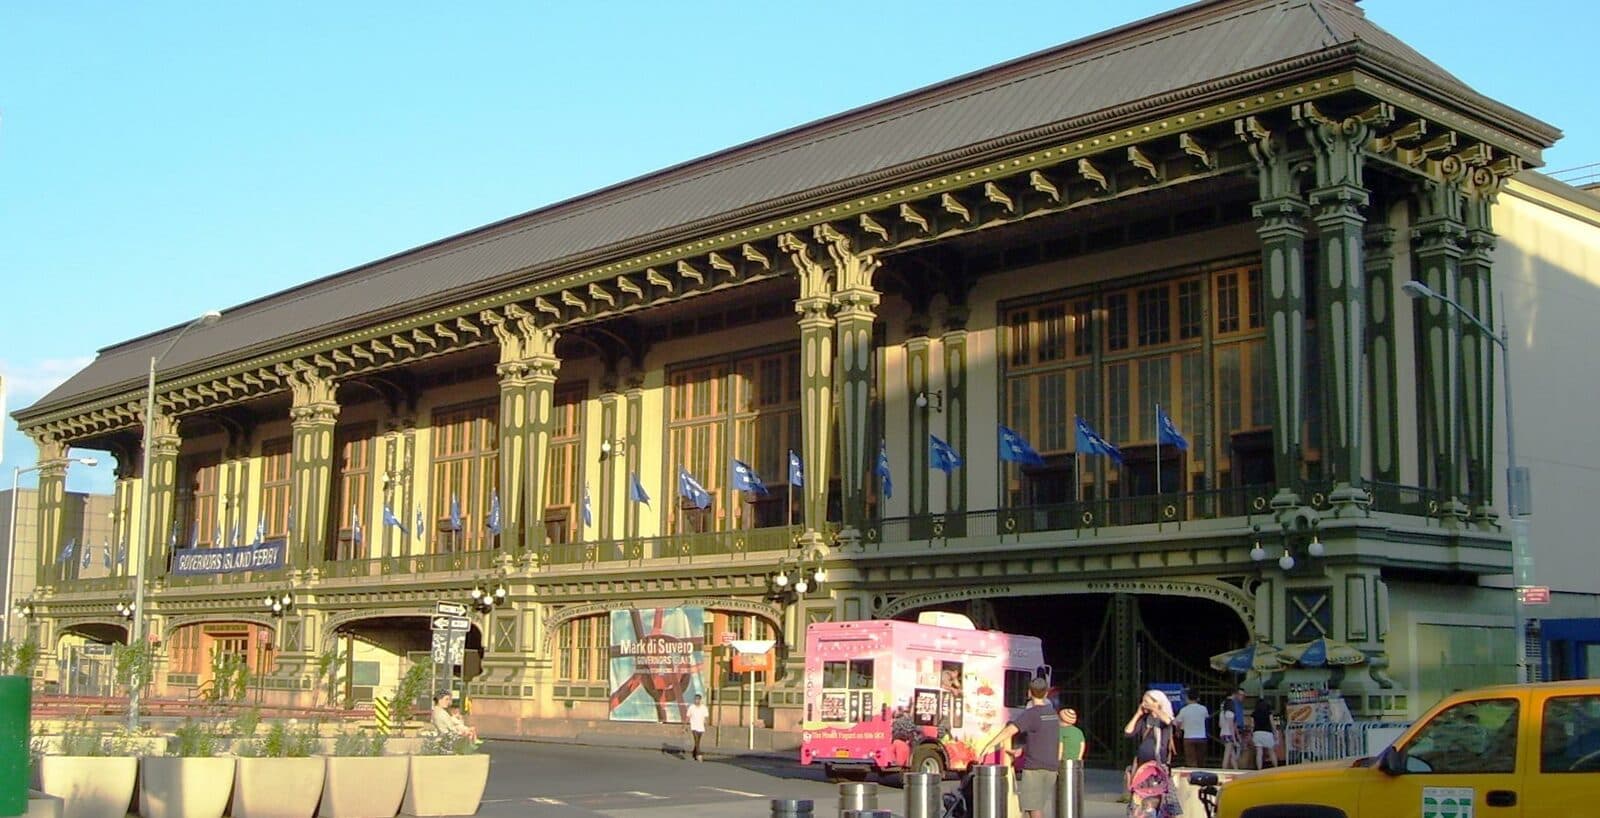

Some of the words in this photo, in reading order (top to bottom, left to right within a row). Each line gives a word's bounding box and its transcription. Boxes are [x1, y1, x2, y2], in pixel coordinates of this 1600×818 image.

[179, 553, 222, 570] GOVERNORS
[222, 551, 252, 569] ISLAND
[252, 547, 280, 566] FERRY
[620, 639, 646, 654] Mark
[647, 639, 656, 654] di
[658, 638, 694, 654] Suvero
